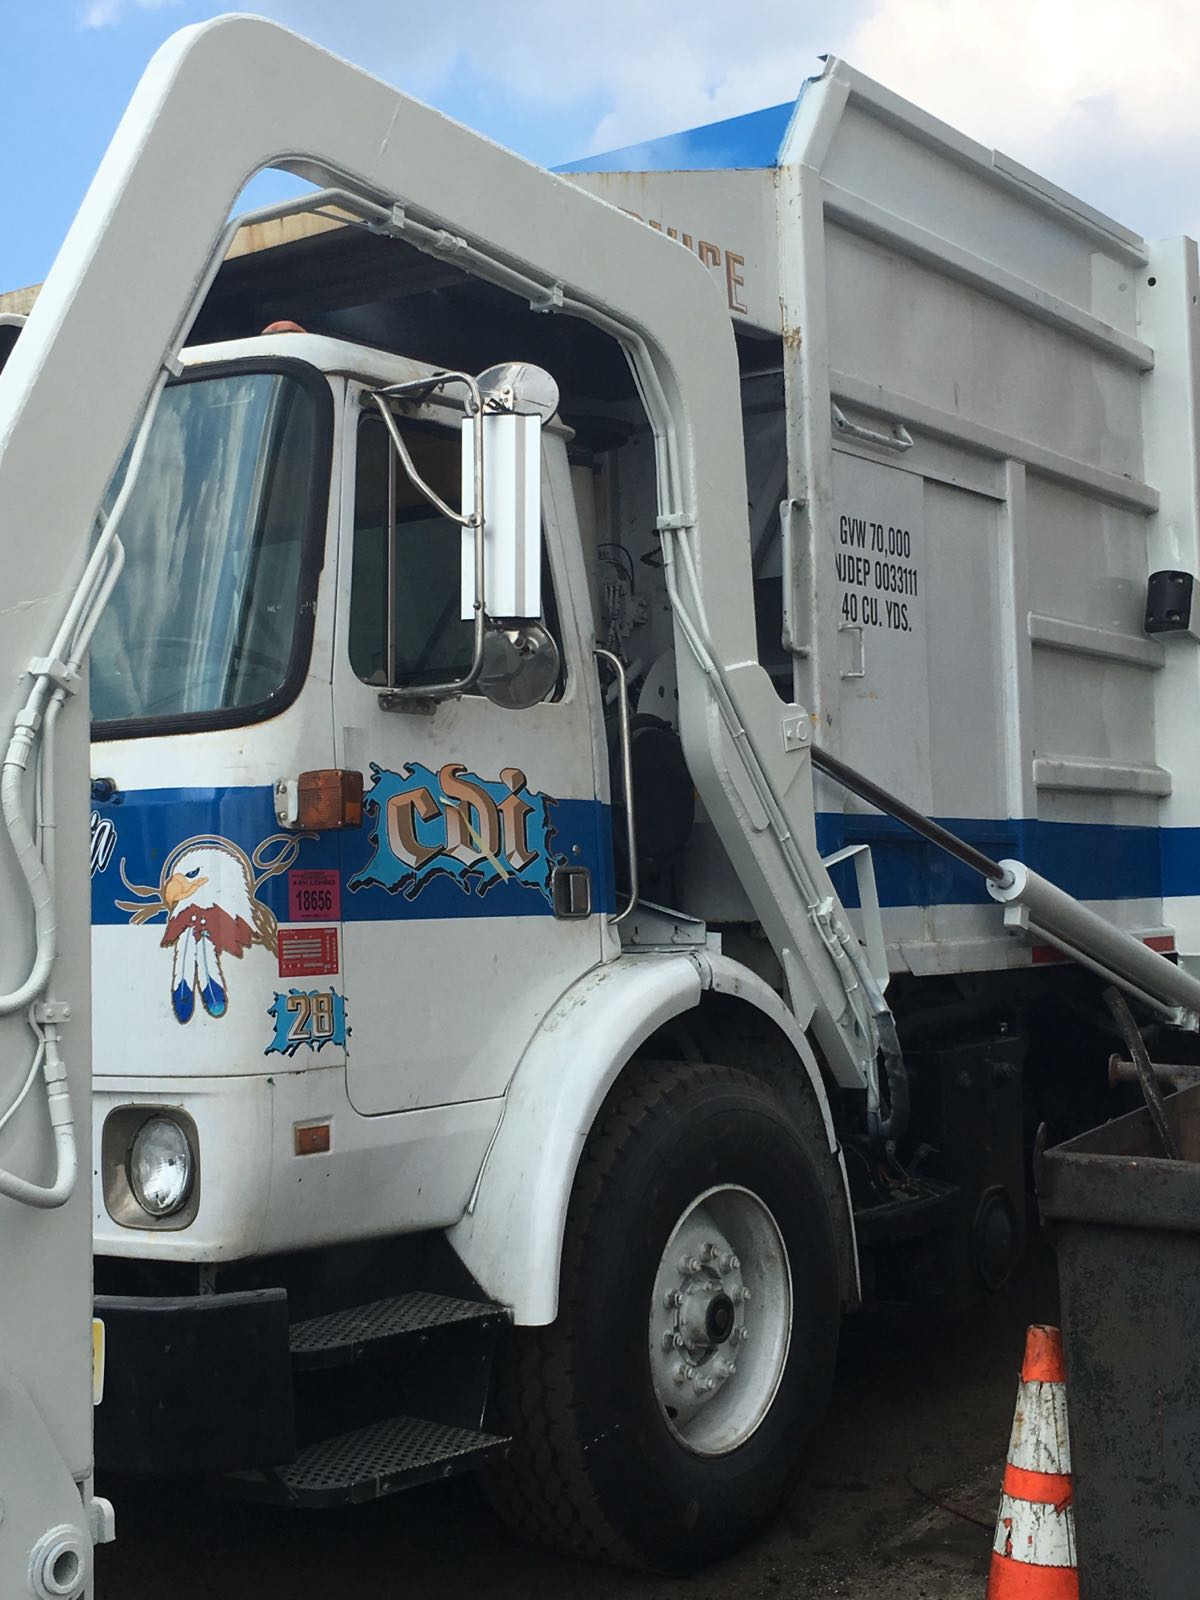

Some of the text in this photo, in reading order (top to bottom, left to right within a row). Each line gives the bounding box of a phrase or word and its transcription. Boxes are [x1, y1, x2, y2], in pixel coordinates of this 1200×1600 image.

[840, 515, 911, 558] GVW 70,000
[835, 552, 918, 597] NJDEP 0033111
[842, 592, 912, 632] 40 CU. YDS.
[296, 889, 332, 911] 18656
[287, 993, 335, 1041] 28
